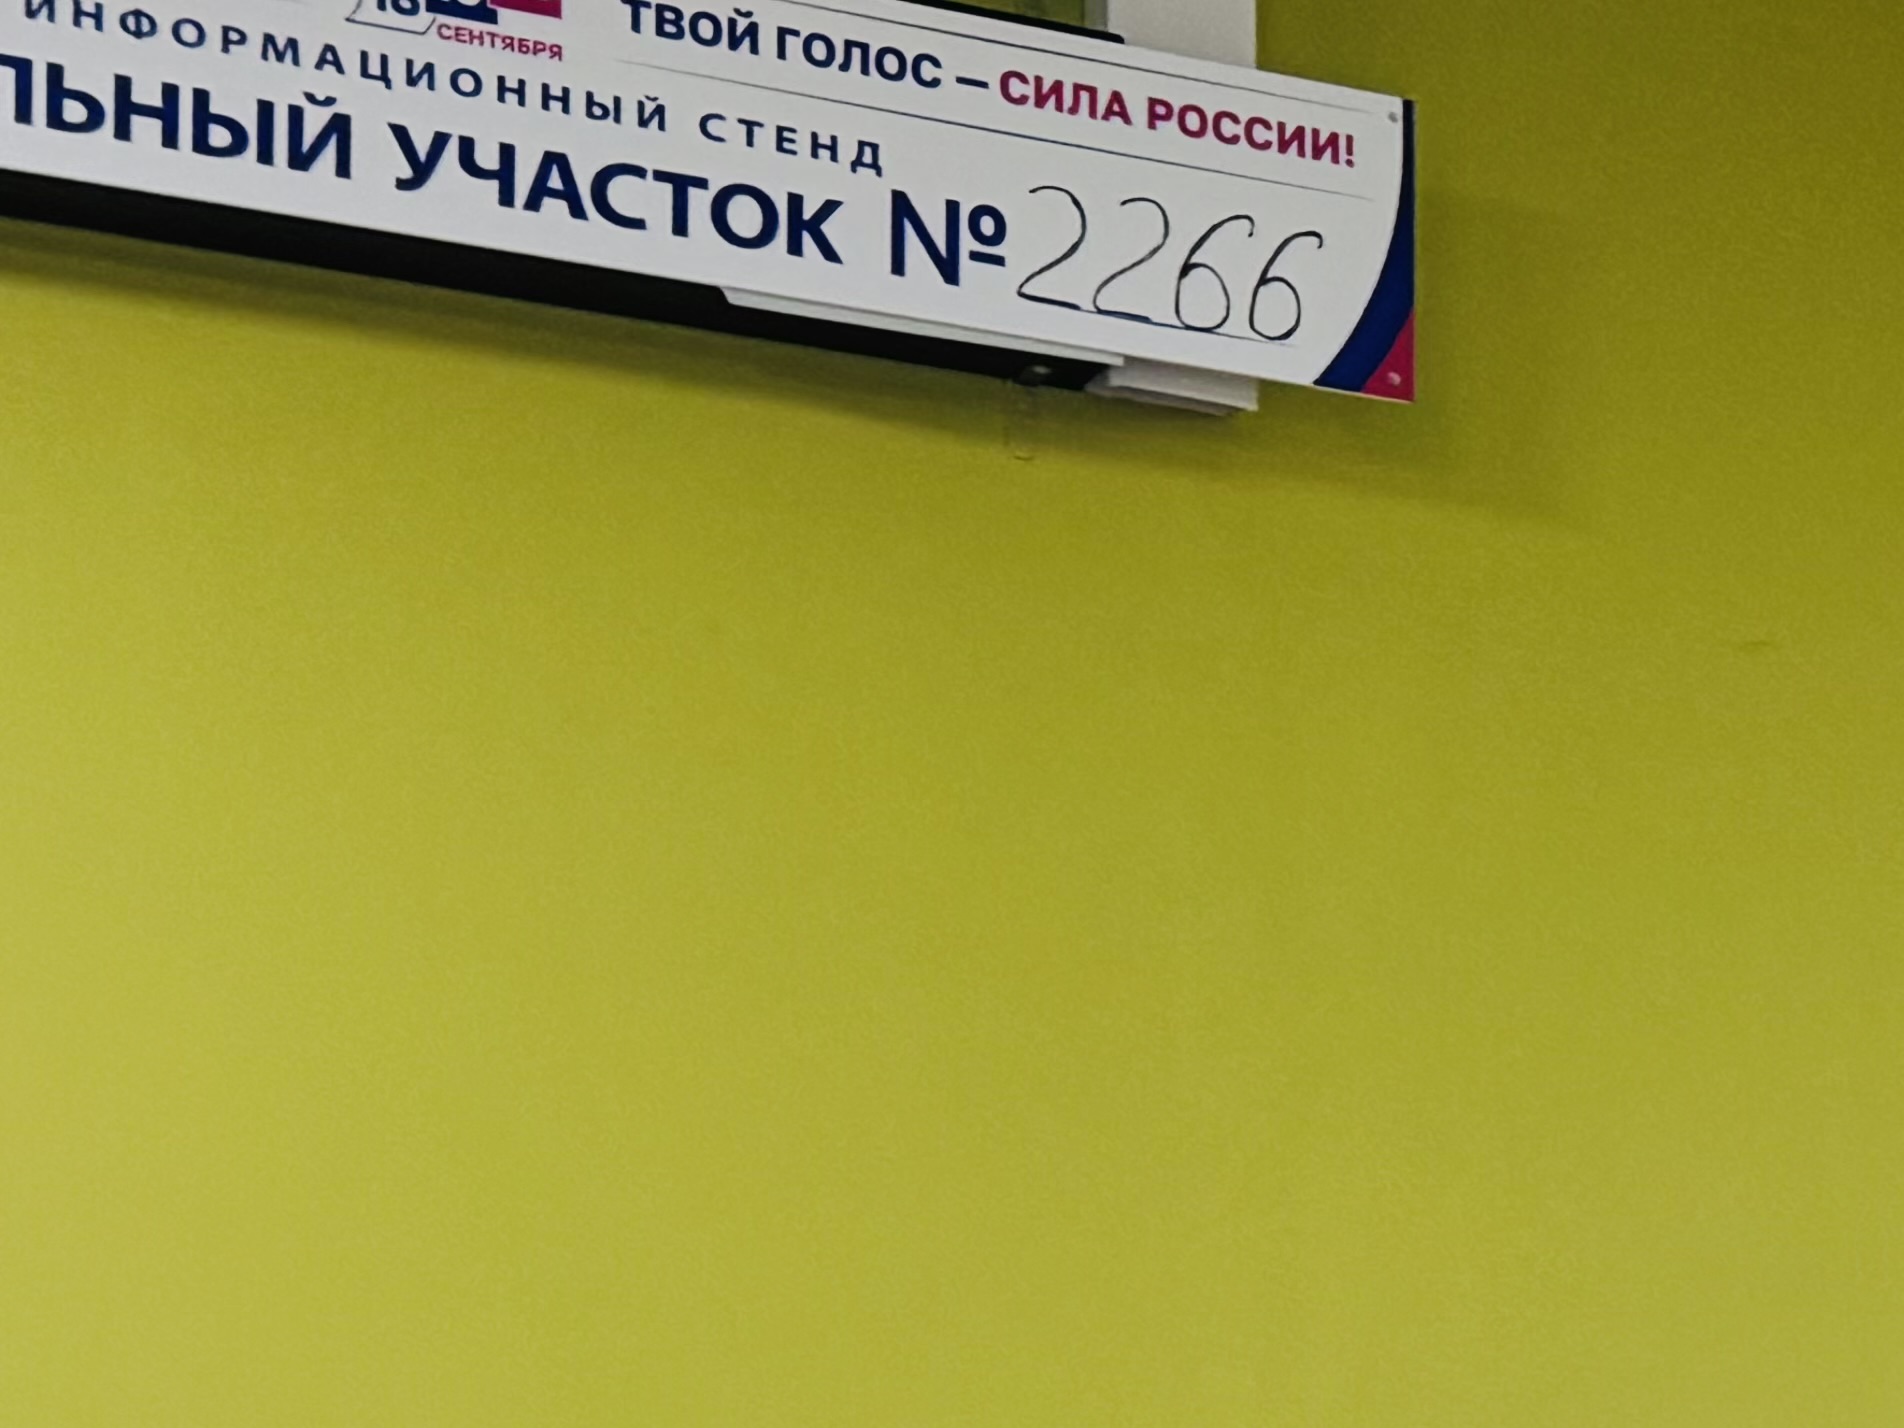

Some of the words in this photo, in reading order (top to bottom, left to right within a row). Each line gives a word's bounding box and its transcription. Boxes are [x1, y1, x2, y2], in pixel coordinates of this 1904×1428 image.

[24, 0, 667, 132] ИНФОРМАЦИОННЫЙ
[698, 112, 884, 178] СТЕНД
[436, 23, 564, 62] СЕНТЯБРЯ
[620, 0, 760, 56] ТВОЙ
[775, 25, 943, 89] ГОЛОС
[999, 70, 1133, 127] СИЛА
[1146, 96, 1356, 168] РОССИИ!
[387, 121, 844, 266] УЧАСТОК
[891, 188, 1007, 287] №
[1016, 185, 1324, 341] 2266
